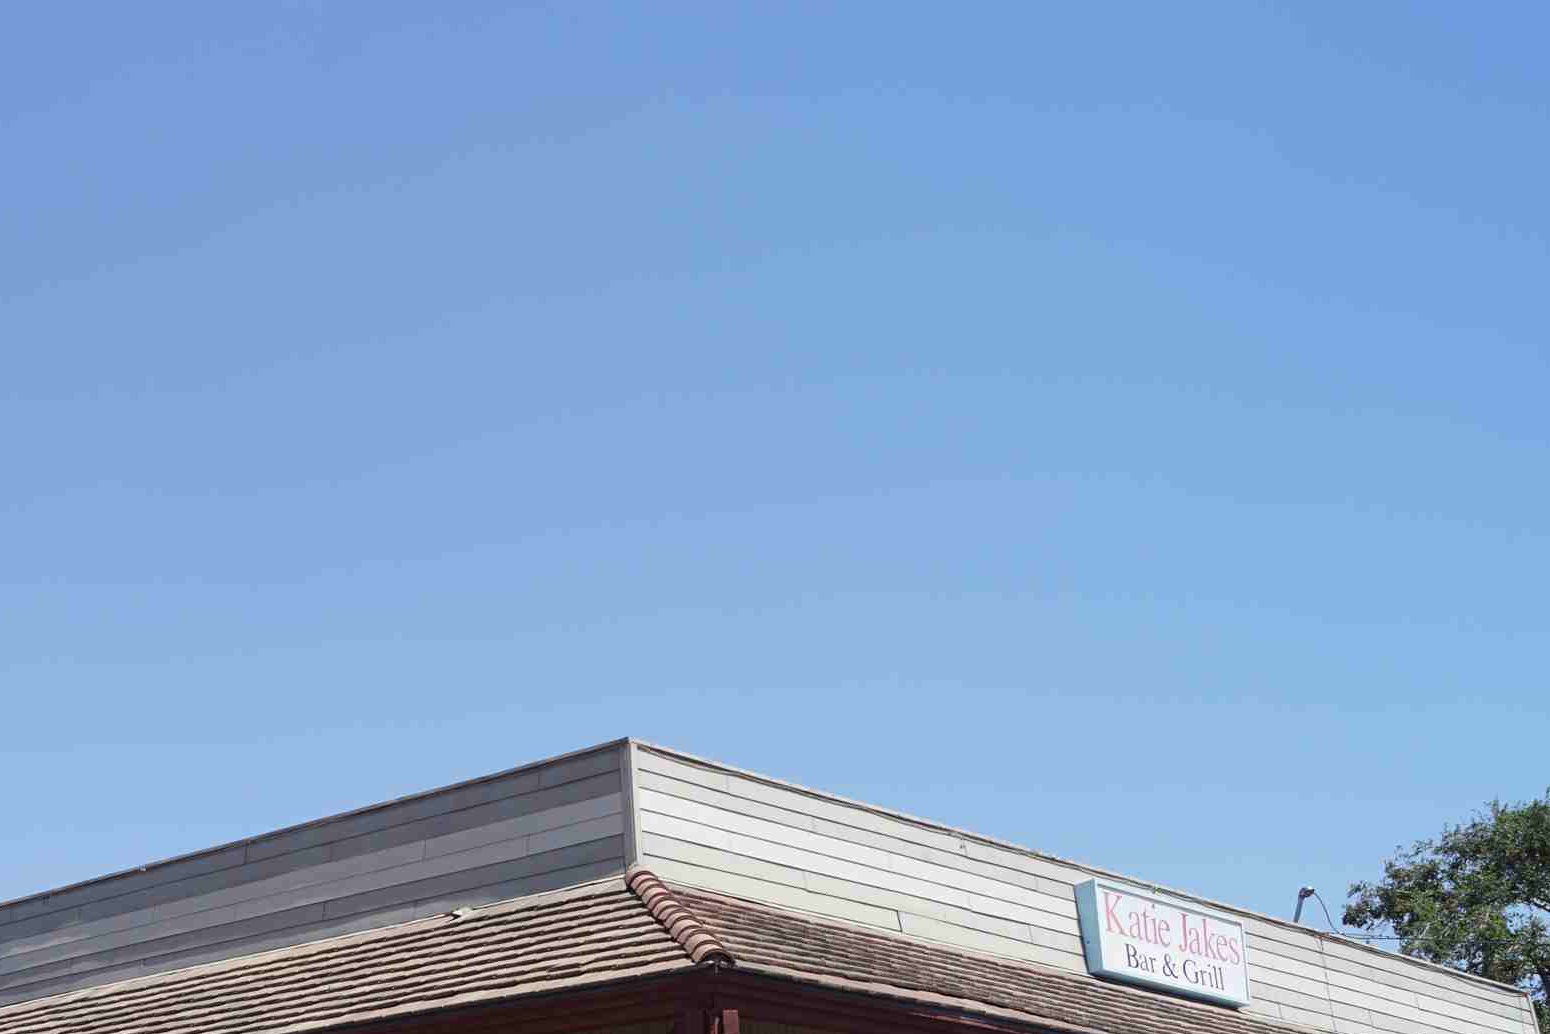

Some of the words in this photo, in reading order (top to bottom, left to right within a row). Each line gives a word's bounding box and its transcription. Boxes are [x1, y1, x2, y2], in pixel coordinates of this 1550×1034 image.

[1103, 891, 1171, 948] Katie
[1178, 911, 1240, 966] Jakes
[1125, 943, 1157, 975] Bar
[1162, 953, 1179, 980] &
[1182, 958, 1225, 991] Grill
